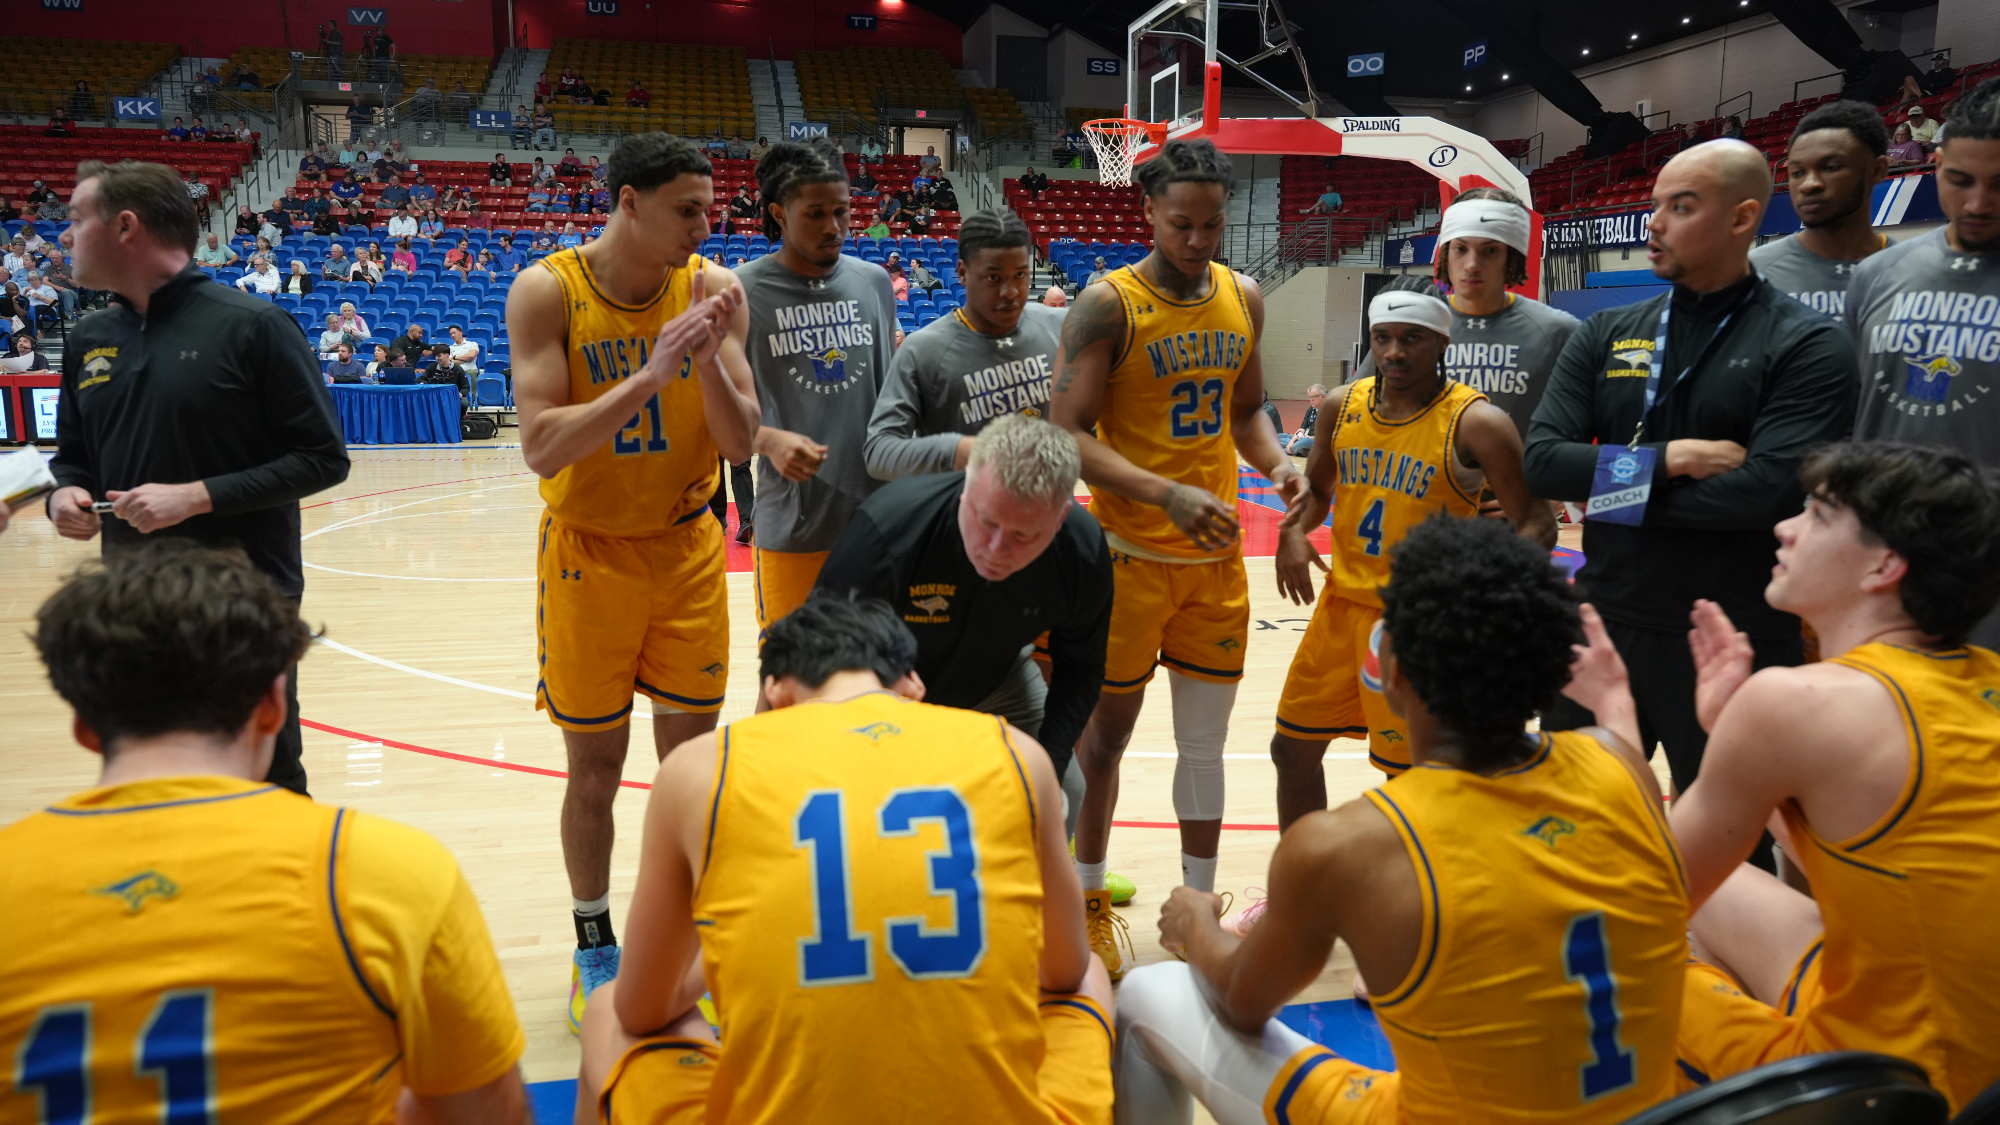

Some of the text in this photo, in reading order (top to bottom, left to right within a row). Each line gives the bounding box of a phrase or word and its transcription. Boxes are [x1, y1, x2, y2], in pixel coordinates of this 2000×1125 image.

[351, 10, 383, 23] VV
[588, 2, 616, 13] UU
[850, 16, 873, 28] TT
[1091, 61, 1117, 73] SS
[1347, 56, 1384, 73] OO
[1464, 45, 1486, 66] PP
[118, 100, 156, 116] KK
[476, 113, 505, 128] LL
[790, 125, 828, 139] MM
[1342, 118, 1401, 133] SPALDING
[774, 300, 862, 331] MONROE
[1888, 290, 2000, 329] MONRO
[768, 323, 874, 358] MUSTANGS
[1145, 329, 1246, 379] MUSTANGS
[1443, 343, 1520, 369] ONROE
[1869, 323, 2000, 363] MUSTANG
[581, 336, 693, 385] MUSTAS
[963, 353, 1053, 398] MONROE
[788, 361, 867, 395] BASKETBALL
[1445, 368, 1530, 396] STANGS
[1874, 369, 1990, 417] BASKETBALL
[960, 378, 1053, 425] MUSTANG
[1171, 377, 1225, 439] 23
[1336, 448, 1436, 500] MUSTANGS
[1592, 489, 1644, 511] COACH
[1357, 497, 1387, 557] 4
[792, 784, 987, 988] 13
[1561, 909, 1637, 1102] 1
[12, 986, 218, 1125] 11
